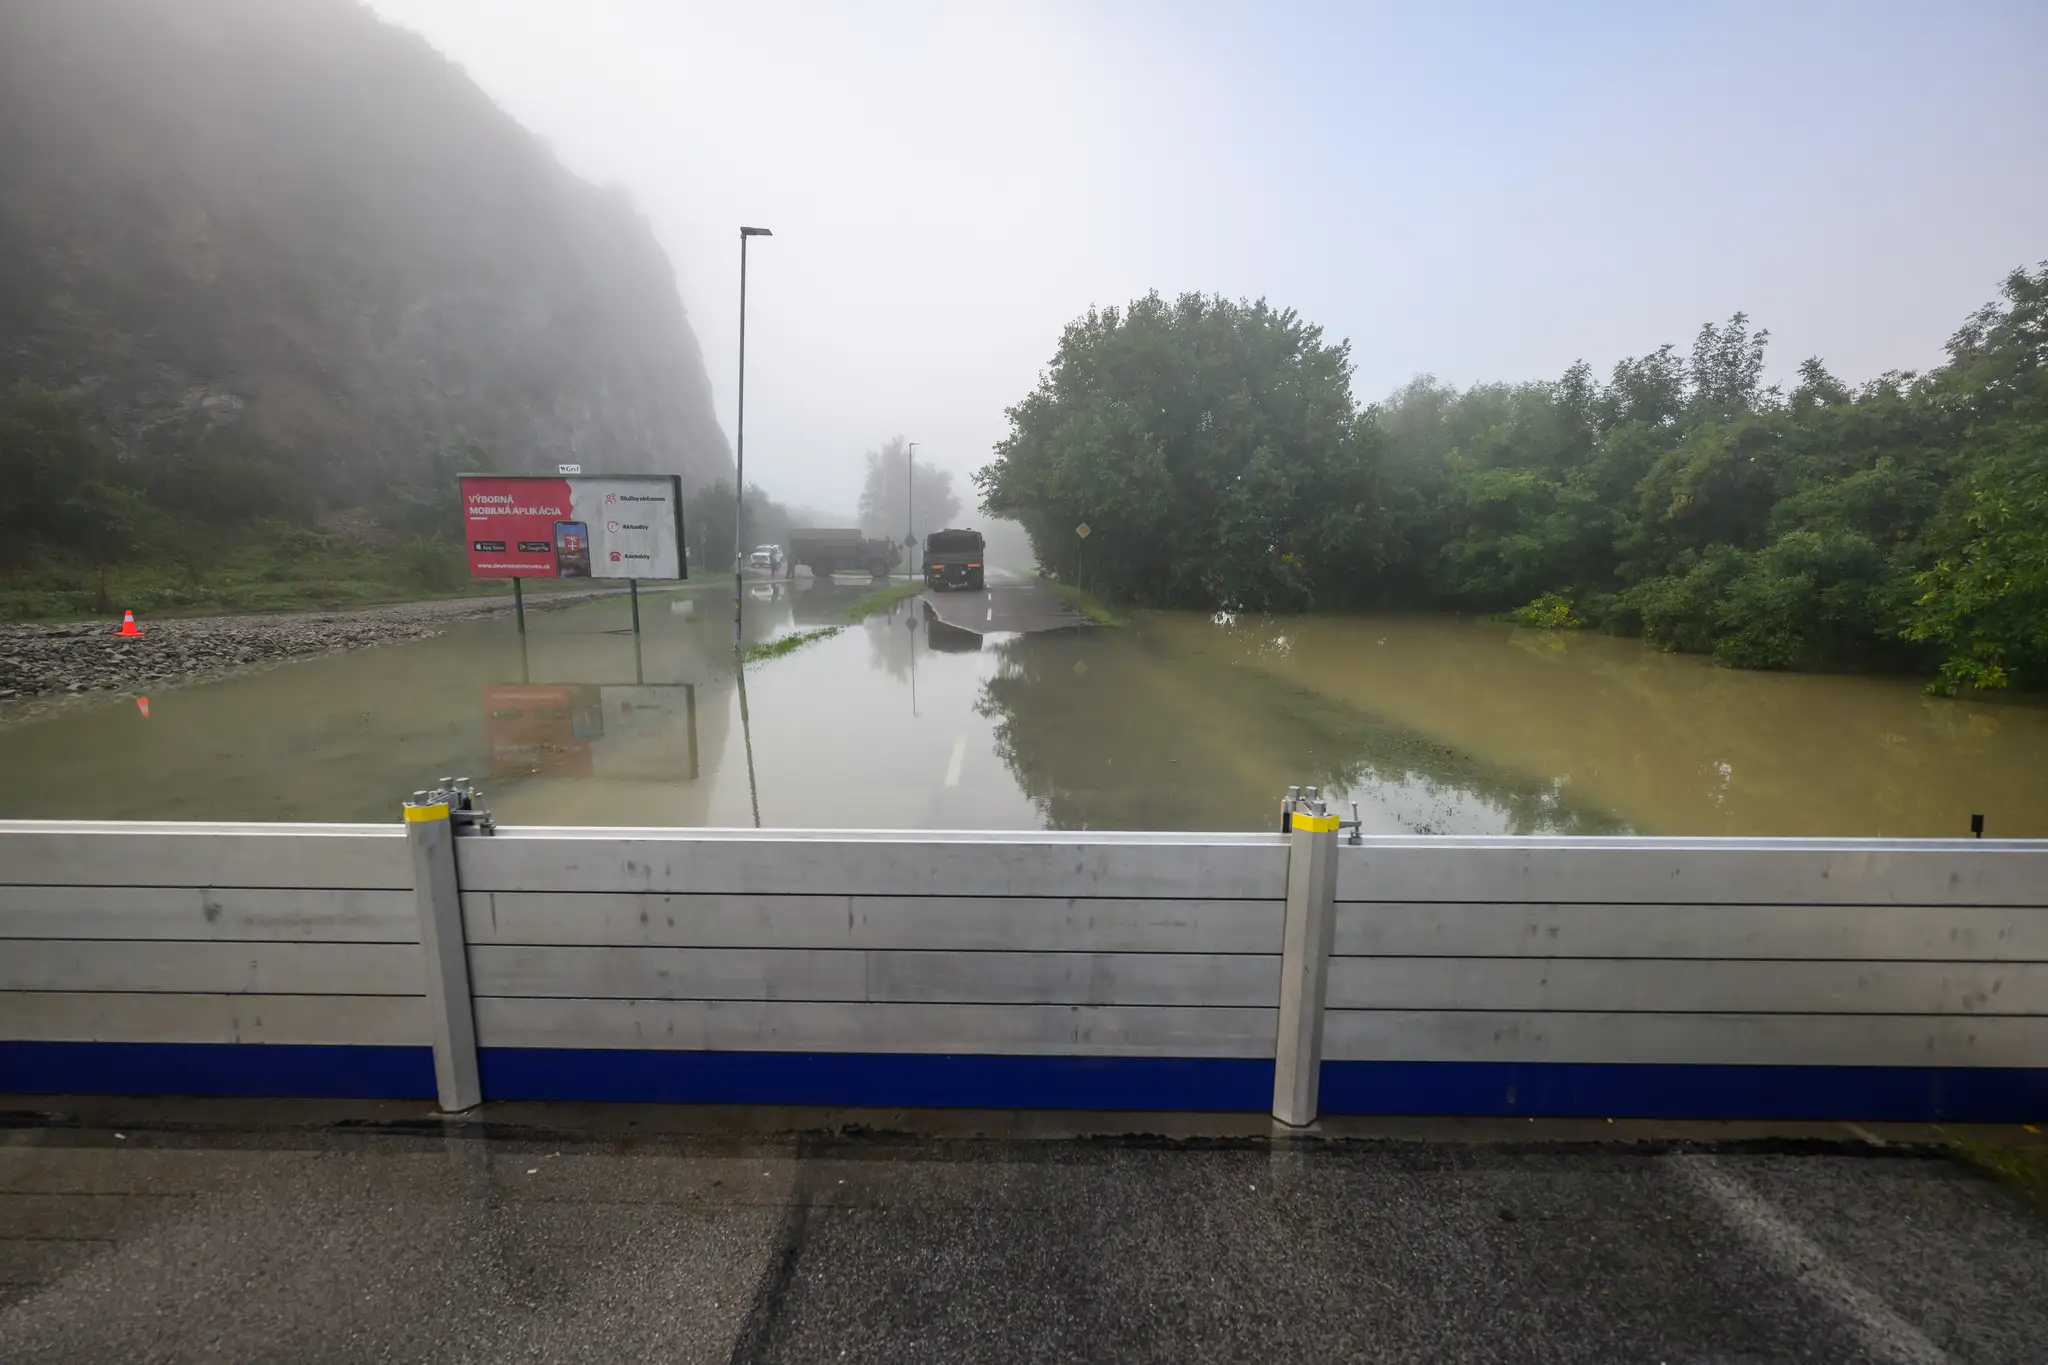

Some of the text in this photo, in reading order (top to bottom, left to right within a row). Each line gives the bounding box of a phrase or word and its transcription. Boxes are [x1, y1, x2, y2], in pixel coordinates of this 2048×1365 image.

[468, 494, 513, 503] VÝBORNÁ
[469, 505, 561, 515] MOBILNÁ APLIKÁCIA
